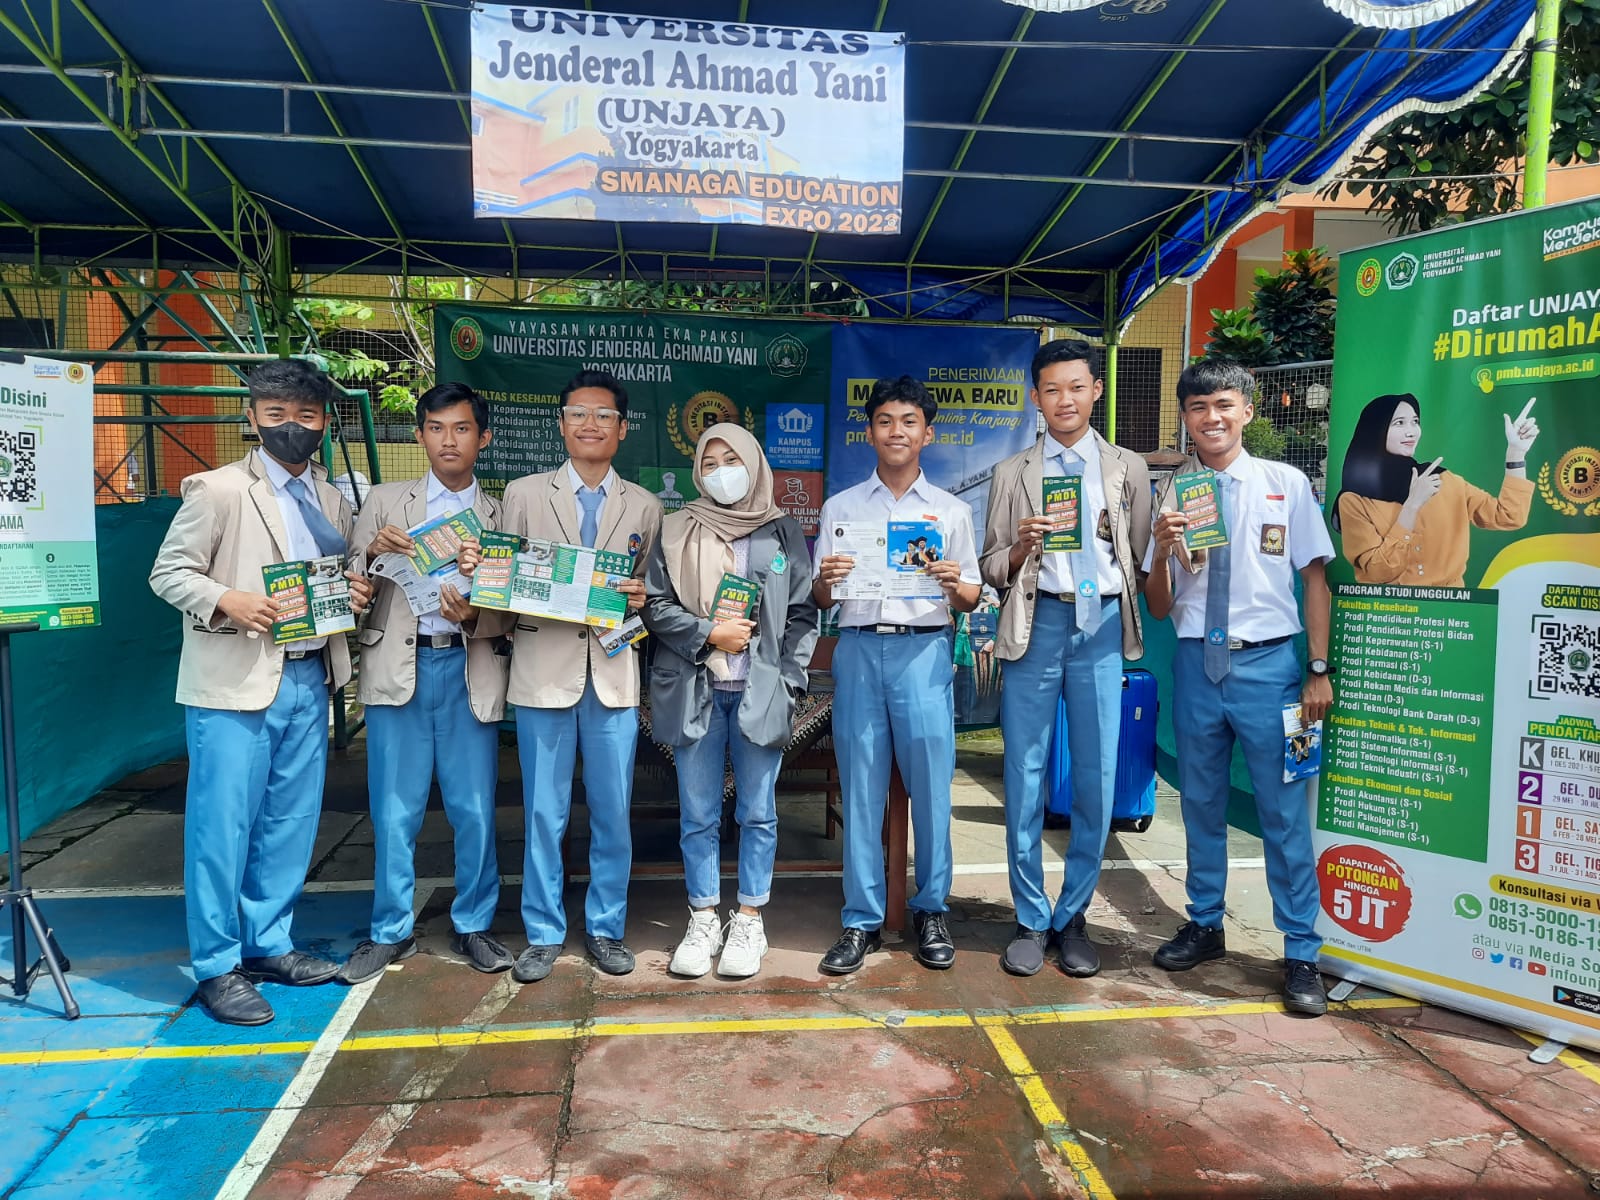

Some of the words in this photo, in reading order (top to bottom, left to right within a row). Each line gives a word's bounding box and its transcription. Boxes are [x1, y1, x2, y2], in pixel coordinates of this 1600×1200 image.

[510, 7, 870, 56] UNIVERSITAS
[489, 40, 654, 86] Jenderal
[669, 51, 797, 96] Ahmad
[809, 62, 887, 102] Yani
[598, 98, 785, 137] (UNJAYA)
[625, 130, 758, 162] Yogyakarta
[601, 171, 741, 195] SMANAGA
[749, 177, 898, 207] EDUCATION
[765, 206, 830, 230] EXPO
[838, 212, 898, 233] 2022
[1544, 228, 1600, 254] Merdek
[1423, 258, 1454, 270] JENDERAL
[1456, 252, 1484, 263] ACHMAD
[1486, 249, 1501, 258] YANI
[1424, 247, 1464, 261] UNIVERSITAS
[1423, 265, 1463, 278] YOGYAKARTA
[1453, 303, 1523, 327] Daftar
[1529, 288, 1600, 317] UNJAY
[509, 320, 580, 337] YAYASAN
[589, 324, 654, 339] KARTIKA
[664, 327, 691, 341] EKA
[701, 329, 746, 344] PAKSI
[493, 335, 586, 358] UNIVERSITAS
[590, 338, 659, 360] JENDERAL
[663, 342, 724, 364] ACHMAD
[727, 345, 757, 366] YANI
[928, 367, 1025, 382] PENERIMAAN
[1496, 359, 1594, 382] pmb.unjaya.ac.id
[1, 386, 47, 408] Disini
[972, 388, 1018, 406] BARU
[494, 404, 550, 415] Keperawatan
[494, 416, 539, 426] Kebidanan
[703, 412, 718, 428] B
[970, 412, 1022, 430] Kunjungi
[493, 428, 528, 438] Farmasi
[532, 430, 552, 439] (S-1)
[778, 438, 812, 446] KAMPUS
[493, 439, 539, 449] Kebidanan
[542, 442, 564, 451] (D-3)
[493, 451, 522, 460] Rekam
[526, 452, 552, 462] Medis
[494, 462, 534, 473] Teknologi
[1575, 467, 1588, 483] B
[1047, 490, 1076, 503] PMDK
[1182, 483, 1213, 501] PMDK
[482, 549, 513, 557] PMDK
[270, 576, 303, 592] PMDK
[1339, 585, 1381, 596] PROGRAM
[1385, 587, 1411, 598] STUDI
[1415, 589, 1470, 600] UNGGULAN
[1549, 586, 1581, 595] DAFTAR
[721, 590, 750, 602] PMDK
[1544, 595, 1577, 607] SCAN
[1338, 600, 1370, 610] Fakultas
[1374, 601, 1418, 613] Kesehatan
[1345, 612, 1364, 621] Prodi
[1367, 614, 1411, 624] Pendidikan
[1414, 617, 1444, 627] Profesi
[1448, 619, 1469, 628] Ners
[1344, 623, 1363, 632] Prodi
[1366, 625, 1410, 636] Pendidikan
[1414, 629, 1444, 638] Profesi
[1448, 631, 1473, 640] Bidan
[1343, 634, 1363, 643] Prodi
[1366, 636, 1418, 648] Keperawatan
[1421, 640, 1443, 651] (S-1)
[1343, 645, 1362, 654] Prodi
[1365, 647, 1407, 659] Kebidanan
[1410, 651, 1432, 662] (S-1)
[1342, 656, 1362, 665] Prodi
[1365, 659, 1397, 669] Farmasi
[1400, 661, 1421, 672] (S-1)
[1341, 667, 1361, 677] Prodi
[1364, 670, 1406, 682] Kebidanan
[1409, 674, 1431, 685] (D-3)
[1340, 690, 1381, 702] Kesehatan
[1384, 694, 1404, 706] (D-3)
[1341, 678, 1361, 688] Prodi
[1364, 681, 1391, 691] Rekam
[1394, 684, 1418, 695] Medis
[1422, 686, 1437, 696] dan
[1441, 690, 1484, 702] Informasi
[1339, 701, 1359, 711] Prodi
[1363, 703, 1400, 716] Teknologi
[1403, 708, 1424, 719] Bank
[1427, 711, 1453, 723] Darah
[1457, 715, 1480, 726] (D-3)
[1558, 716, 1593, 728] JADWAL
[1331, 714, 1366, 727] Fakultas
[1369, 720, 1395, 731] Teknik
[1399, 724, 1405, 733] &
[1409, 726, 1427, 736] Tek.
[1431, 728, 1476, 742] Informasi
[1338, 728, 1358, 738] Prodi
[1362, 731, 1406, 745] Informatika
[1409, 738, 1431, 749] (S-1)
[1337, 738, 1358, 748] Prodi
[1361, 741, 1388, 752] Sistem
[1391, 746, 1431, 759] Informasi
[1434, 752, 1457, 764] (S-1)
[1522, 742, 1542, 767] K
[1551, 746, 1575, 760] GEL.
[1336, 759, 1357, 769] Prodi
[1360, 762, 1384, 774] Teknik
[1388, 766, 1419, 779] Industri
[1422, 773, 1444, 785] (S-1)
[1337, 749, 1357, 759] Prodi
[1361, 751, 1398, 766] Teknologi
[1401, 758, 1442, 772] Informasi
[1445, 765, 1468, 778] (S-1)
[1328, 772, 1363, 786] Fakultas
[1366, 779, 1401, 792] Ekonomi
[1405, 784, 1421, 796] dan
[1424, 789, 1453, 801] Sosial
[1521, 776, 1540, 802] 2
[1560, 782, 1584, 797] GEL.
[1335, 787, 1356, 797] Prodi
[1359, 790, 1397, 805] Akuntansi
[1400, 797, 1422, 810] (S-1)
[1334, 797, 1355, 807] Prodi
[1358, 801, 1385, 814] Hukum
[1388, 806, 1409, 819] (S-1)
[1334, 807, 1355, 818] Prodi
[1358, 811, 1394, 826] Psikologi
[1397, 820, 1419, 832] (S-1)
[1522, 810, 1533, 835] 1
[1556, 816, 1580, 831] GEL.
[1585, 821, 1600, 835] SA
[1333, 818, 1354, 828] Prodi
[1358, 822, 1405, 839] Manajemen
[1407, 832, 1430, 845] (S-1)
[1340, 857, 1386, 873] DAPATKAN
[1519, 844, 1536, 870] 3
[1555, 852, 1579, 867] GEL.
[1327, 863, 1399, 891] POTONGAN
[1344, 880, 1380, 896] HINGGA
[1499, 879, 1566, 904] Konsultasi
[1571, 895, 1591, 908] via
[1334, 889, 1352, 920] 5
[1472, 934, 1500, 949] atau
[1505, 941, 1523, 955] via
[1530, 945, 1575, 967] Media
